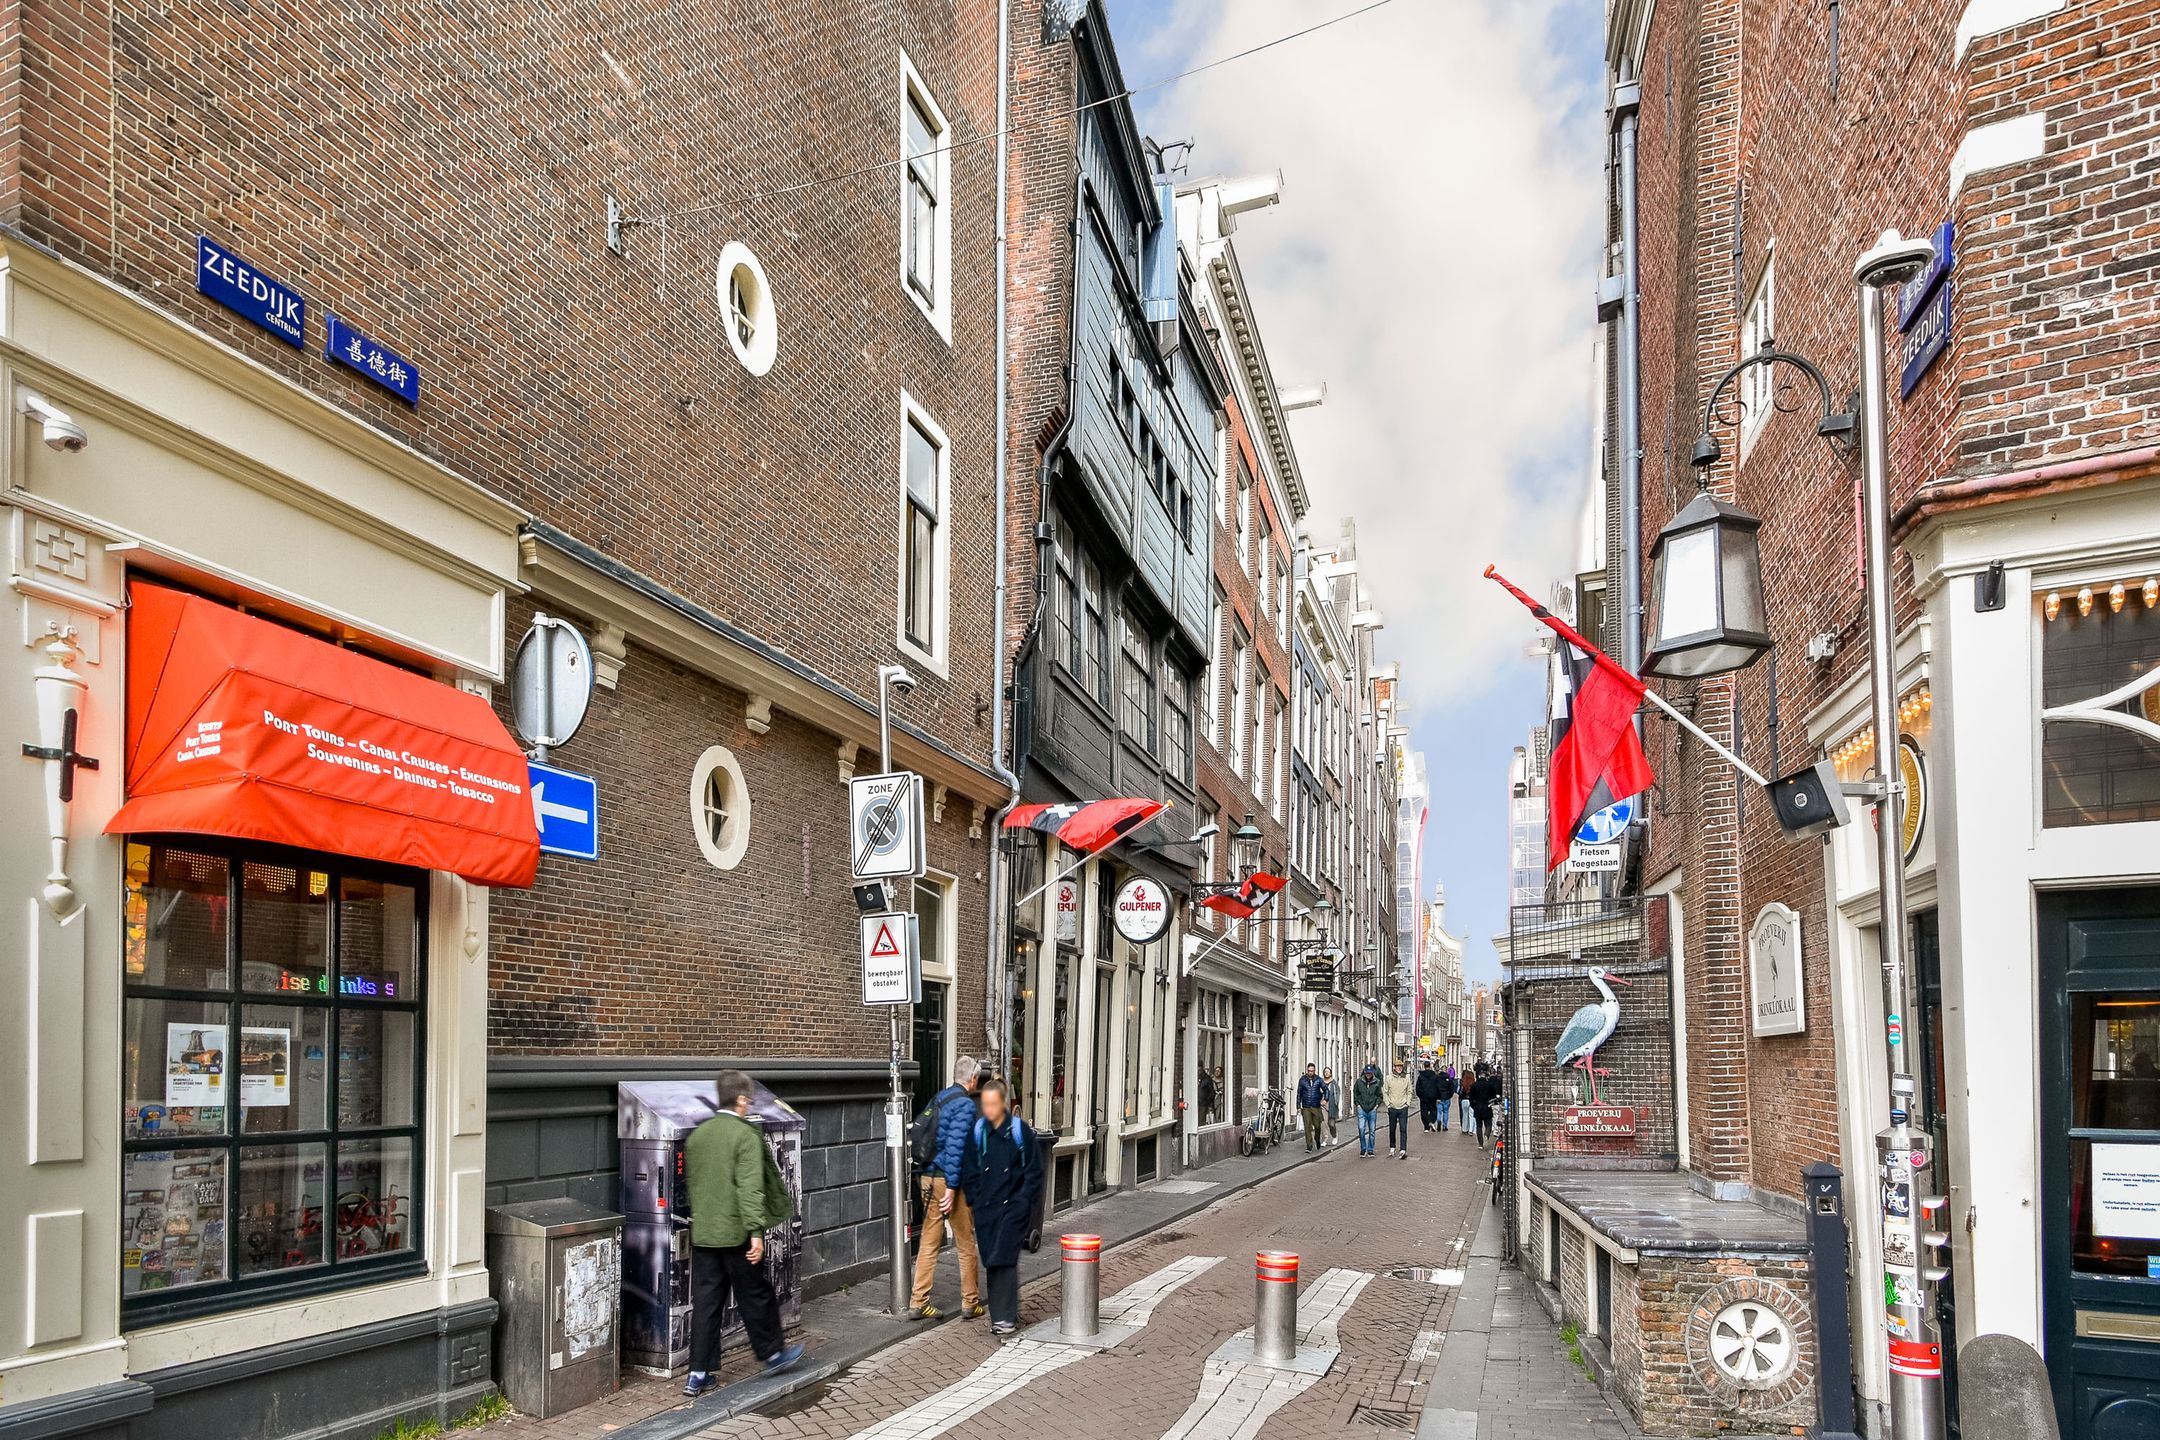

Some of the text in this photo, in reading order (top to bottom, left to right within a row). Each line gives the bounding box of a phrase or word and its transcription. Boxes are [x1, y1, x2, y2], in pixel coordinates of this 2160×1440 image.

[204, 246, 300, 324] ZEEDIJK
[265, 312, 300, 339] CENTRUM
[1902, 295, 1944, 373] ZEEDIJK
[345, 337, 408, 388] 善德街
[263, 709, 299, 736] Port
[301, 723, 345, 748] Tours
[358, 739, 400, 762] Canal
[401, 751, 450, 775] Cruises
[459, 767, 521, 795] Excursions
[307, 742, 381, 775] Souvenirs
[393, 765, 438, 789] Drinks
[448, 780, 495, 804] Tobacco
[867, 783, 893, 795] ZONE
[1907, 779, 1920, 833] GEBROUWEN
[1580, 848, 1610, 856] Fietsen
[1571, 859, 1618, 869] Toegestaan
[1119, 901, 1161, 912] GULPENER
[1758, 923, 1787, 951] PROEVERIJ
[275, 970, 311, 991] ise
[318, 974, 377, 996] dinks
[384, 982, 395, 997] s
[867, 970, 904, 978] beweegbaar
[872, 979, 899, 987] obstakel
[1757, 996, 1796, 1018] DRINKLOKAAL
[1577, 1109, 1622, 1119] PROEVERIJ
[1595, 1117, 1602, 1125] &
[1568, 1124, 1632, 1132] DRINKLOKAAL
